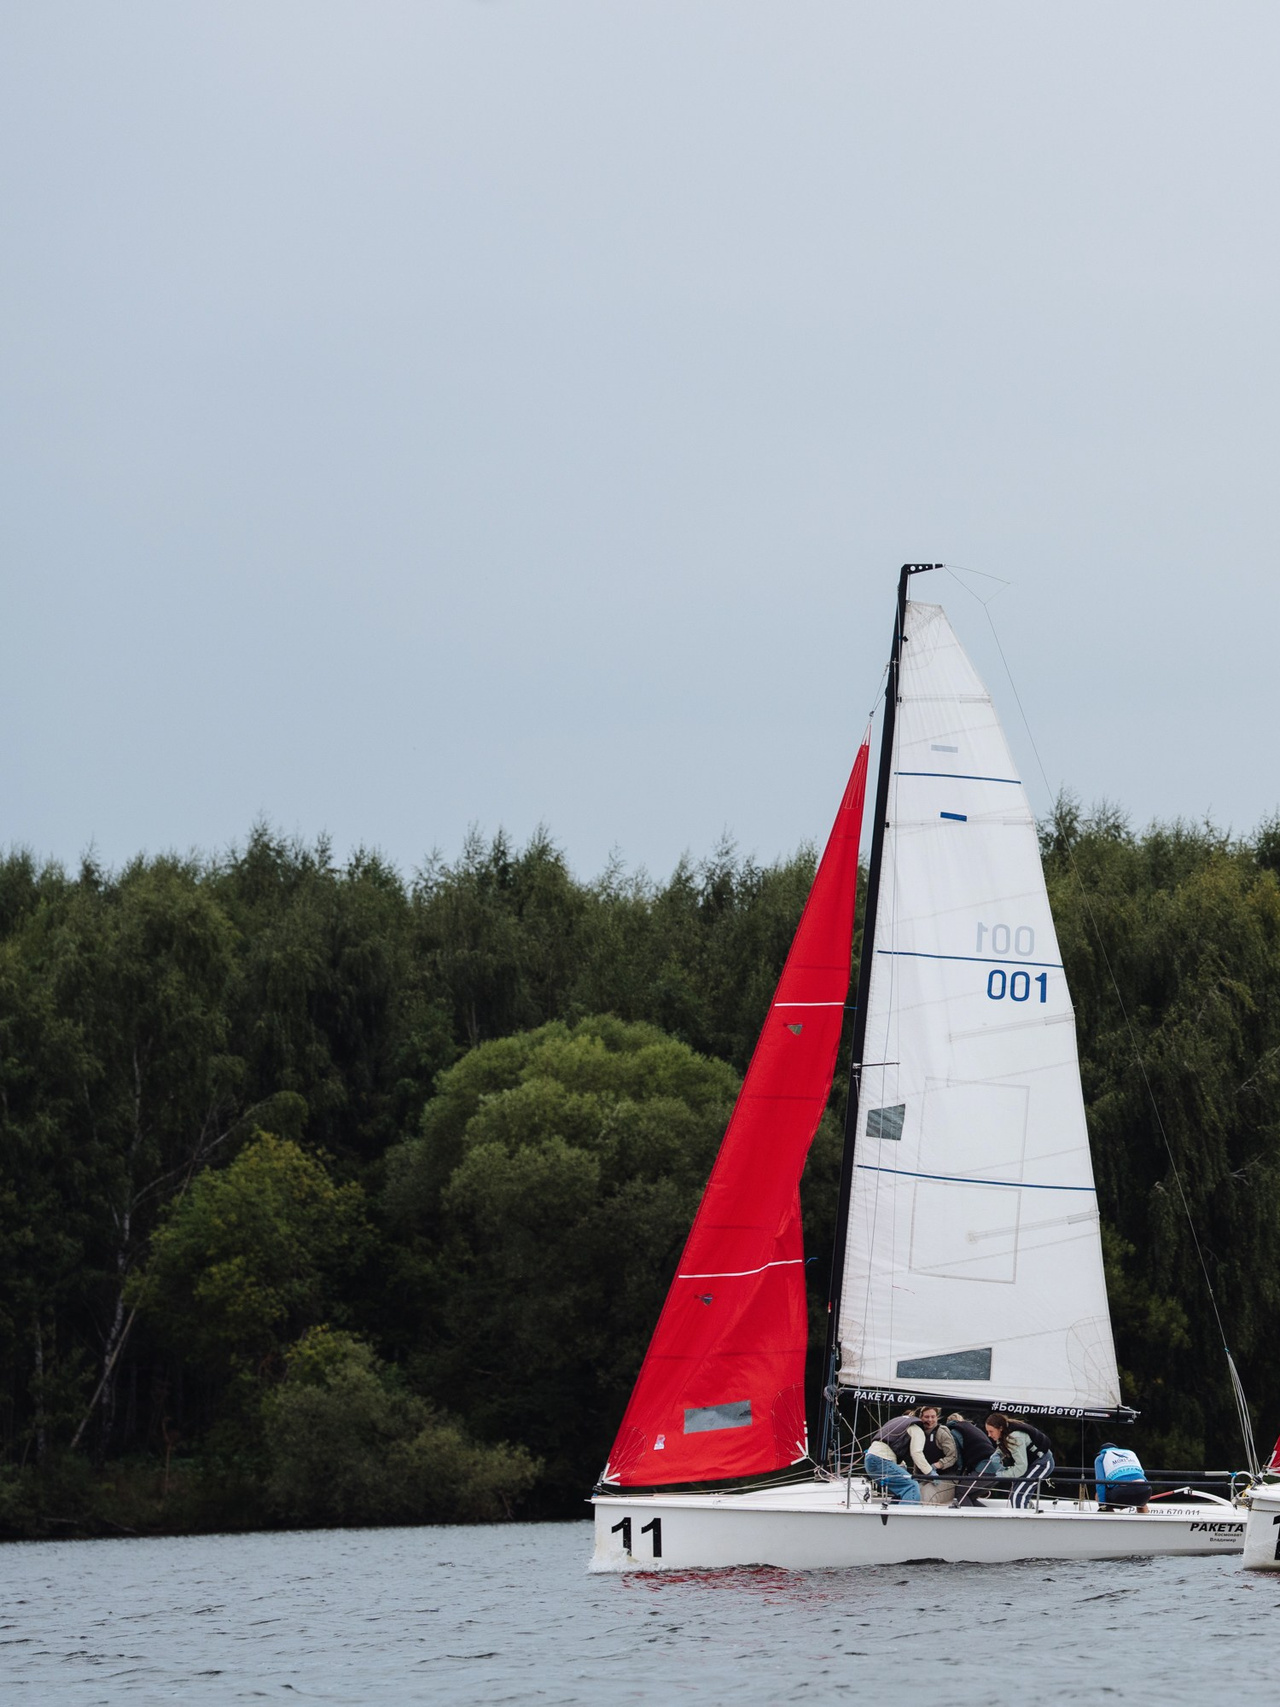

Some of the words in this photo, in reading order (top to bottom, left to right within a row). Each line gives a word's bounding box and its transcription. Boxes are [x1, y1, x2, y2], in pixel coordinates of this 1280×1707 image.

[987, 969, 1048, 1004] 001
[897, 1394, 916, 1404] 670
[991, 1401, 1084, 1418] #БодрыйВетер
[1189, 1522, 1244, 1533] РАКЕТА
[611, 1516, 662, 1558] 11
